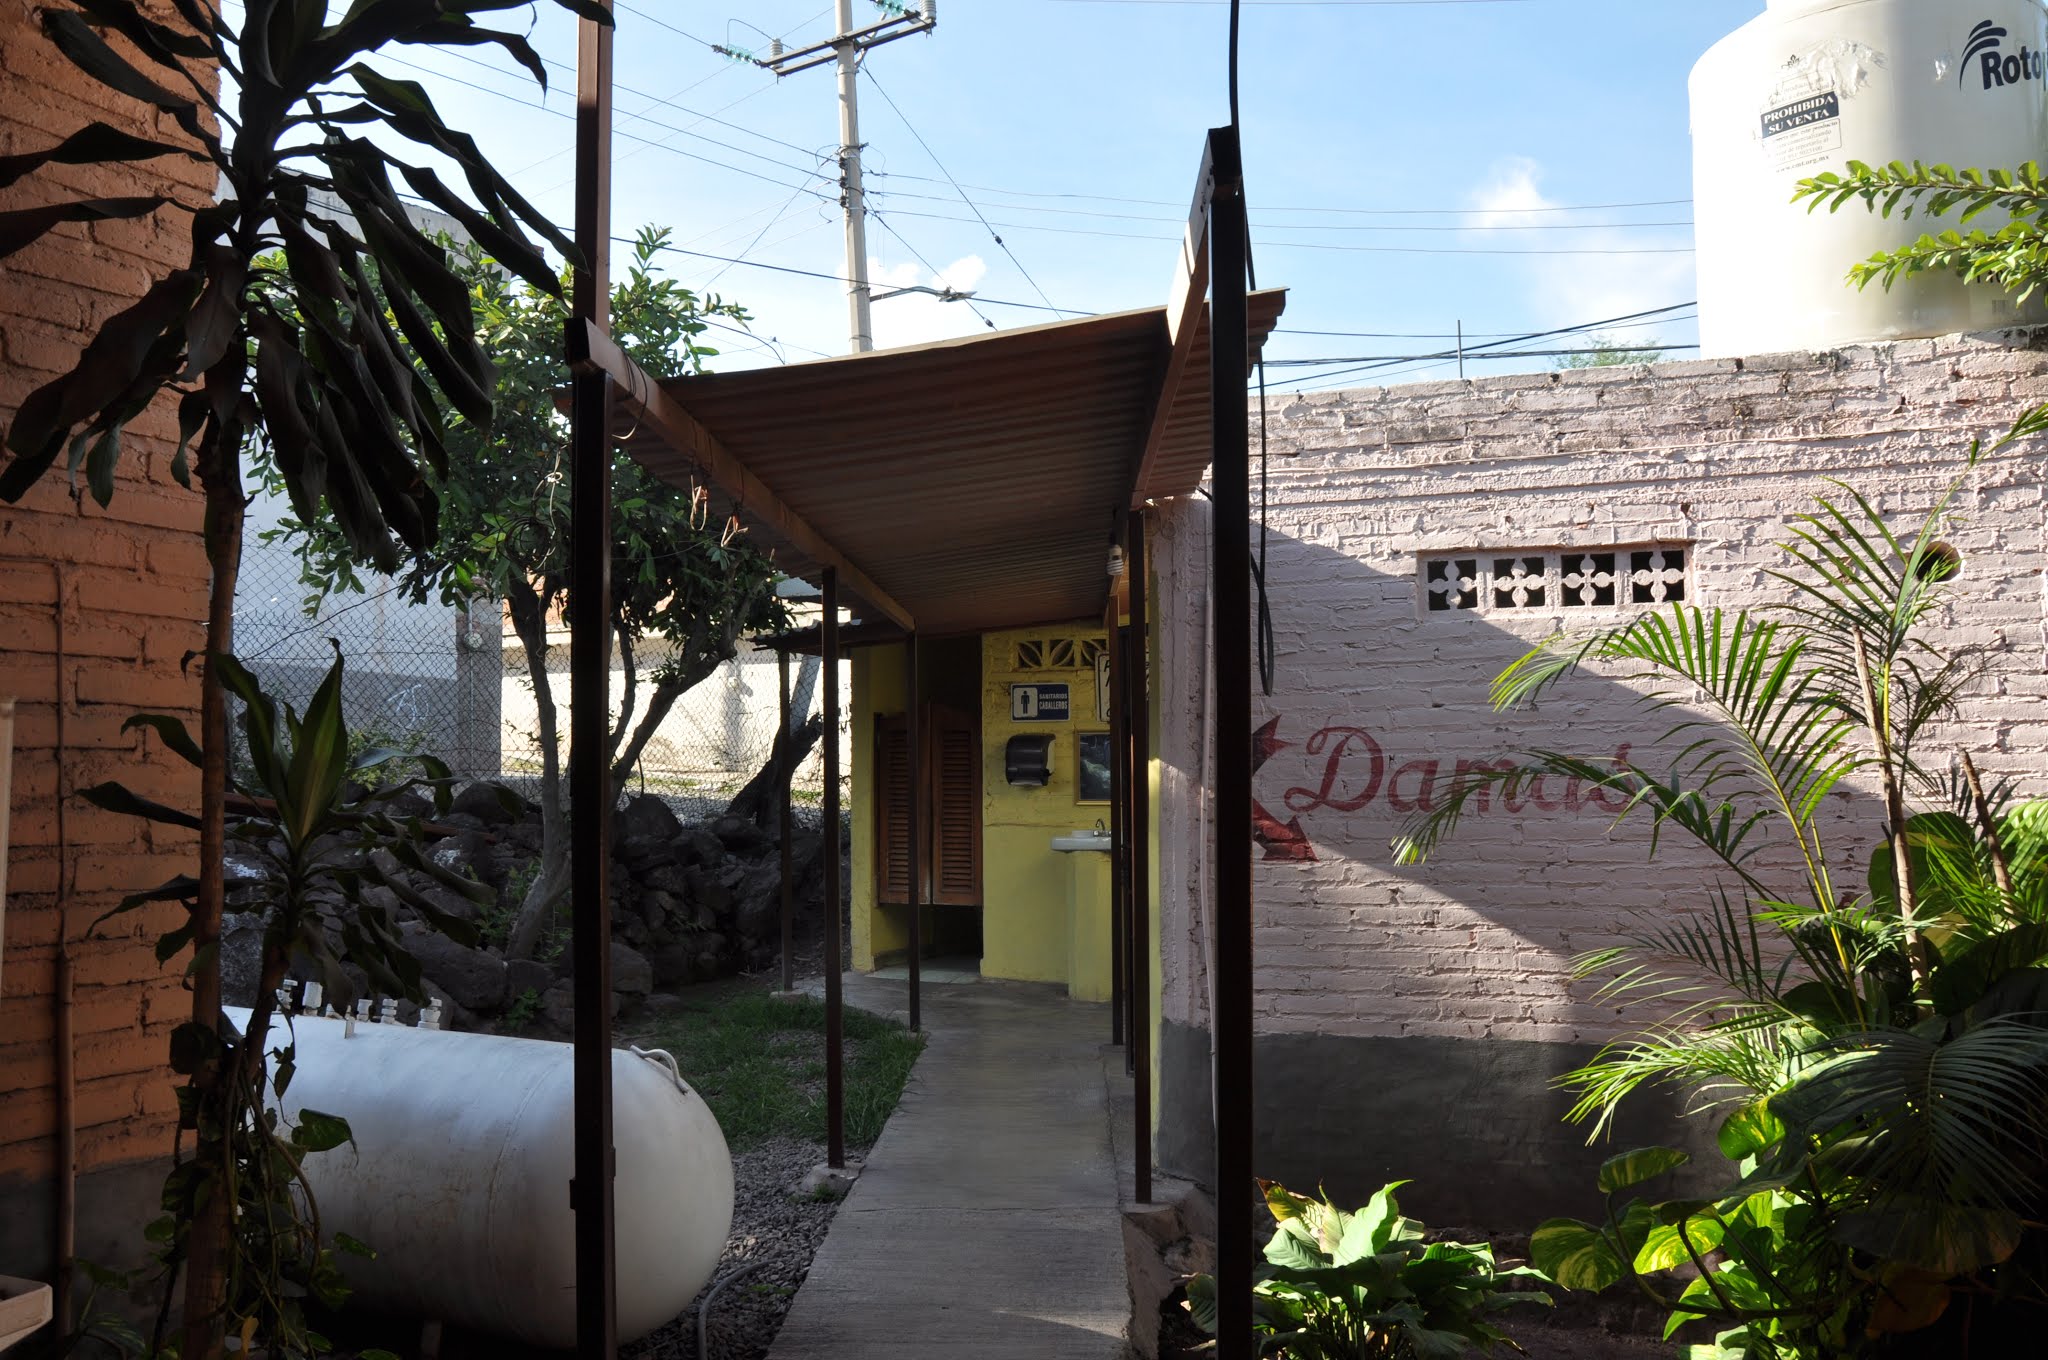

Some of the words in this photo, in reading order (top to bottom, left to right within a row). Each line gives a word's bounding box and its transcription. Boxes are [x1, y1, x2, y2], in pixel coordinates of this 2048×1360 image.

[1763, 95, 1834, 124] PROHIBIDA
[1768, 121, 1784, 135] SU
[1786, 109, 1830, 128] VENTA
[1039, 701, 1068, 710] CABALLEROS
[1284, 726, 1638, 813] Damas
